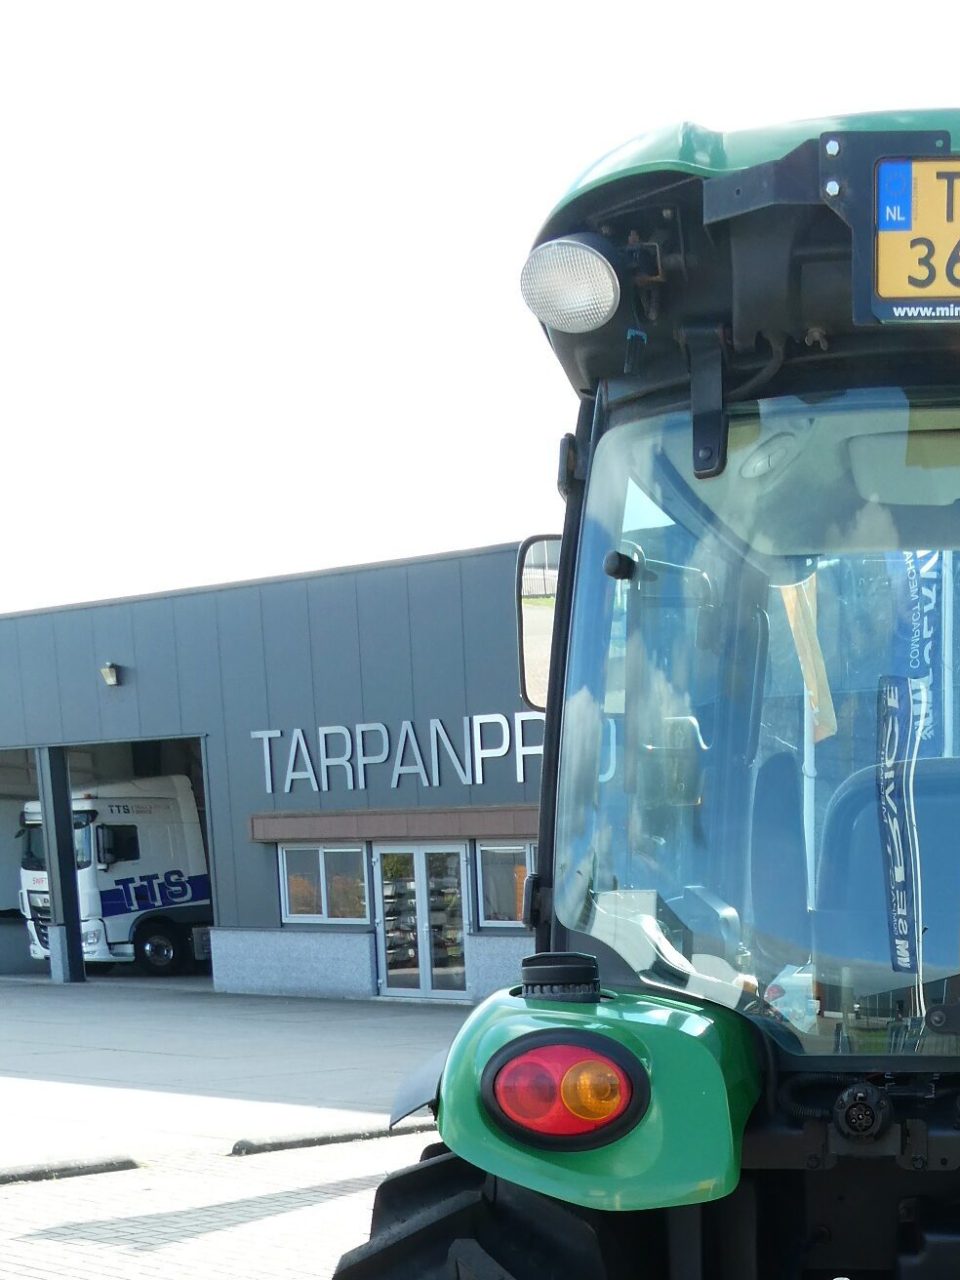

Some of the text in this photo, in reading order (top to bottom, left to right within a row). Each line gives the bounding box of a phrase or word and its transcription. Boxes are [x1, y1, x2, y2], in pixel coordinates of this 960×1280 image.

[886, 206, 905, 222] NL
[108, 804, 130, 814] TTS
[114, 869, 193, 911] TTS
